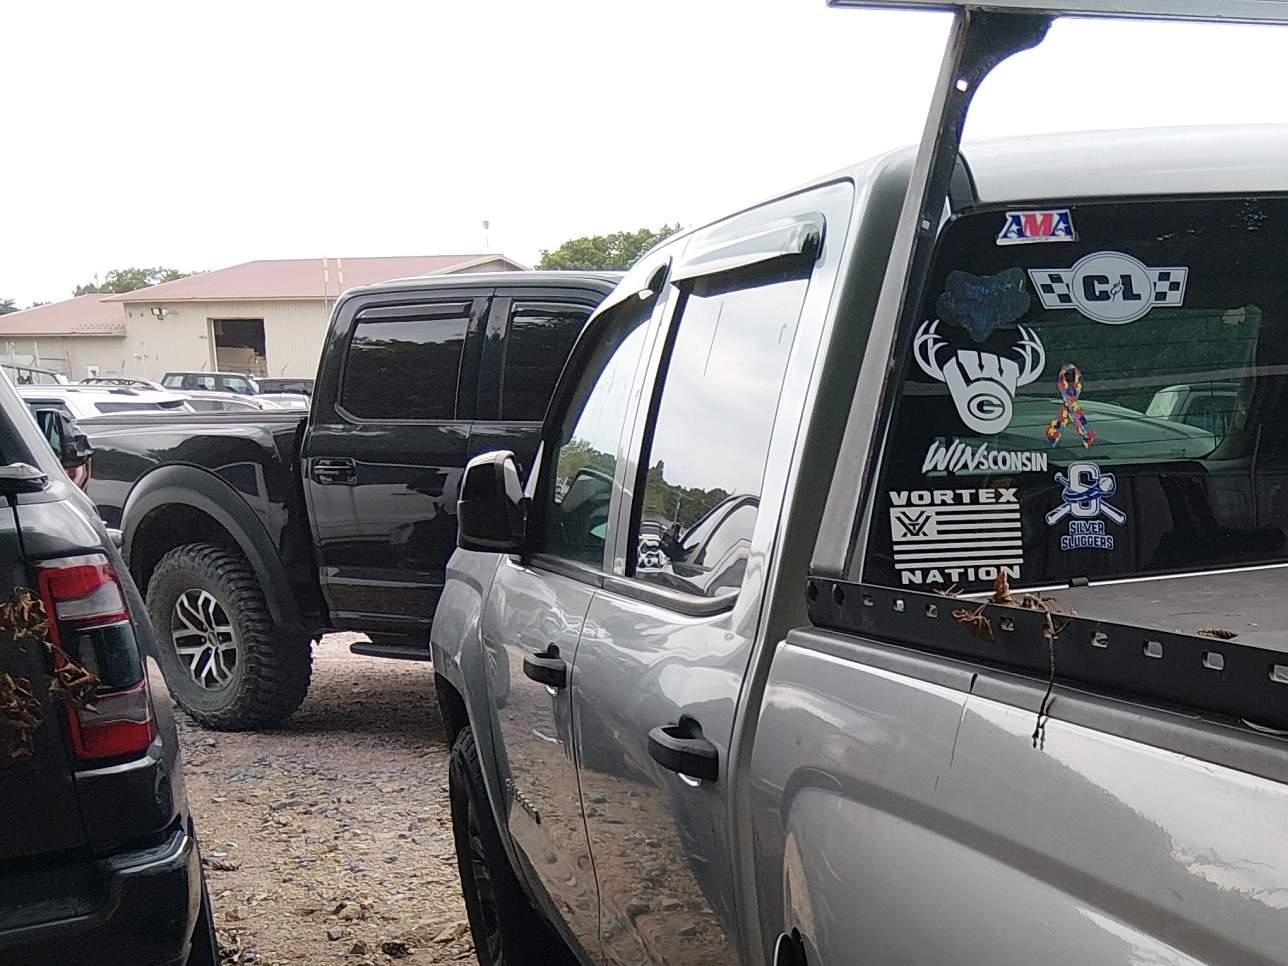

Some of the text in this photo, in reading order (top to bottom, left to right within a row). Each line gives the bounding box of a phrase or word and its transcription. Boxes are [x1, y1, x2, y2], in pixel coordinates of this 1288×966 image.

[1006, 212, 1073, 240] AMA
[888, 487, 1019, 506] VORTEX
[1068, 520, 1105, 536] SILVER
[1061, 534, 1114, 550] SLUGGERS
[901, 564, 1021, 585] NATION
